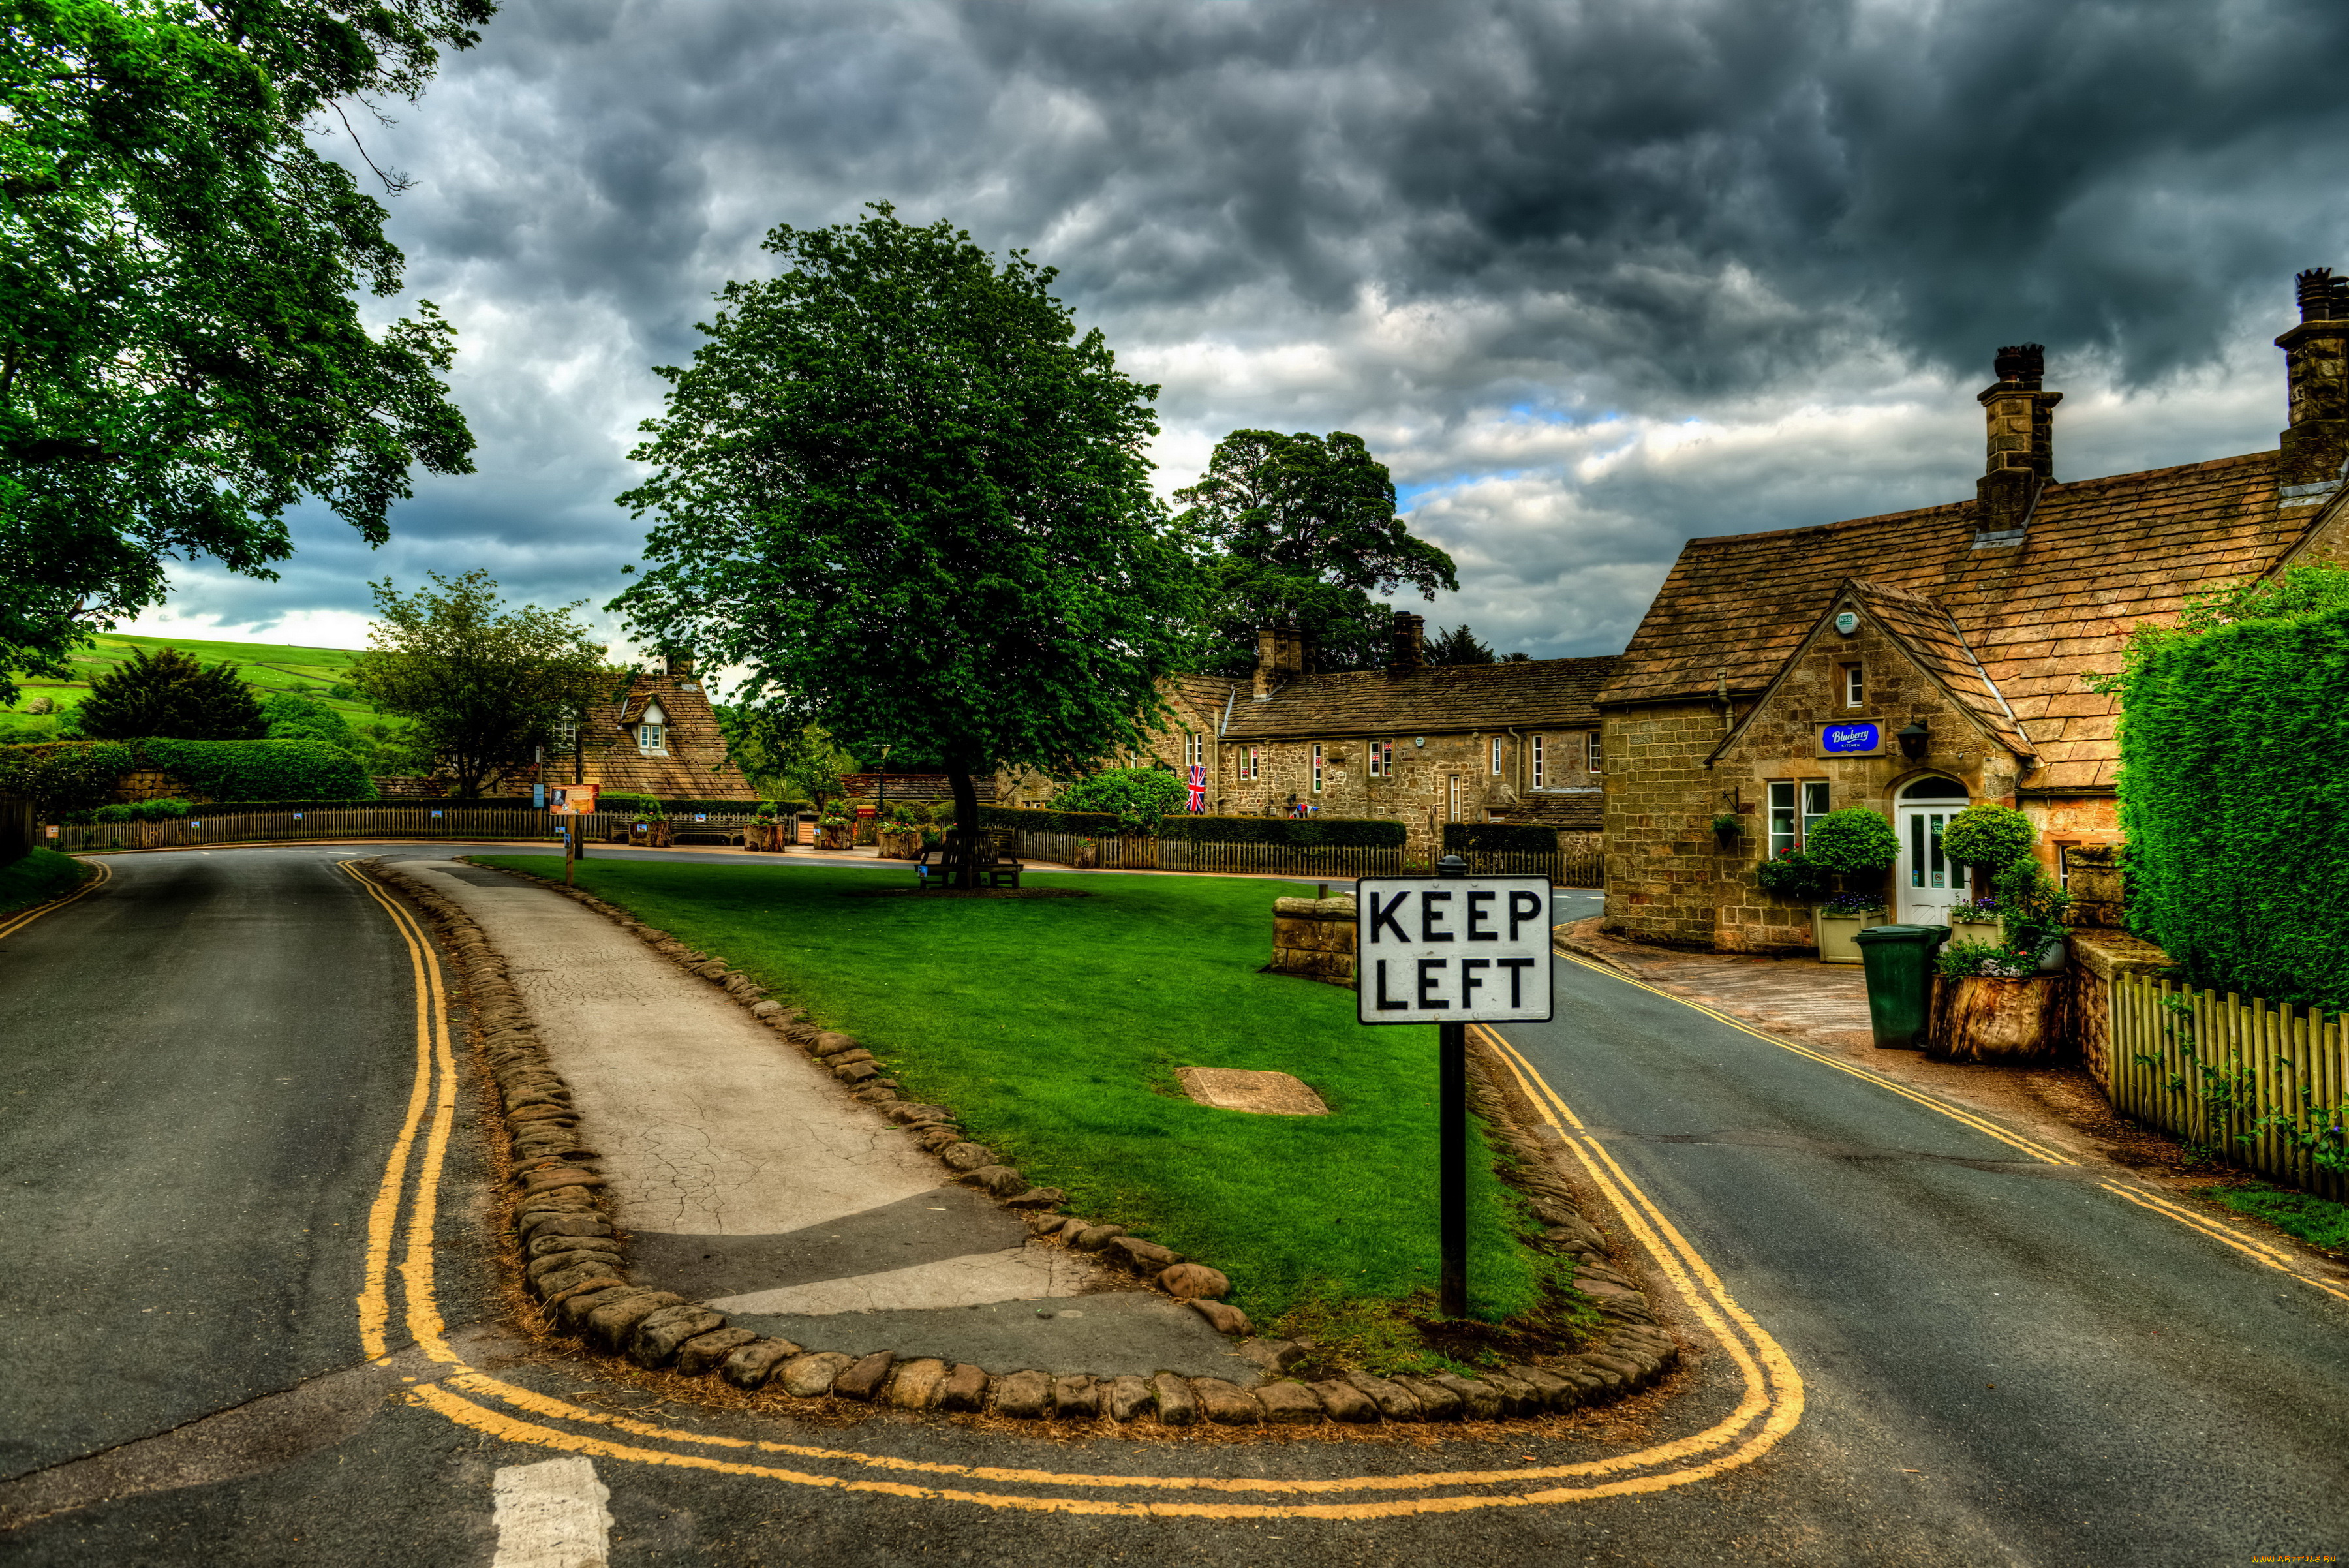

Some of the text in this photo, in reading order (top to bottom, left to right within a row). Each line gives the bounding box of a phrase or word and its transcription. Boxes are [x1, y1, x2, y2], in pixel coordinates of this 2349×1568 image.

[1832, 729, 1869, 743] Blueberry
[1370, 890, 1542, 943] KEEP
[1377, 957, 1535, 1010] LEFT
